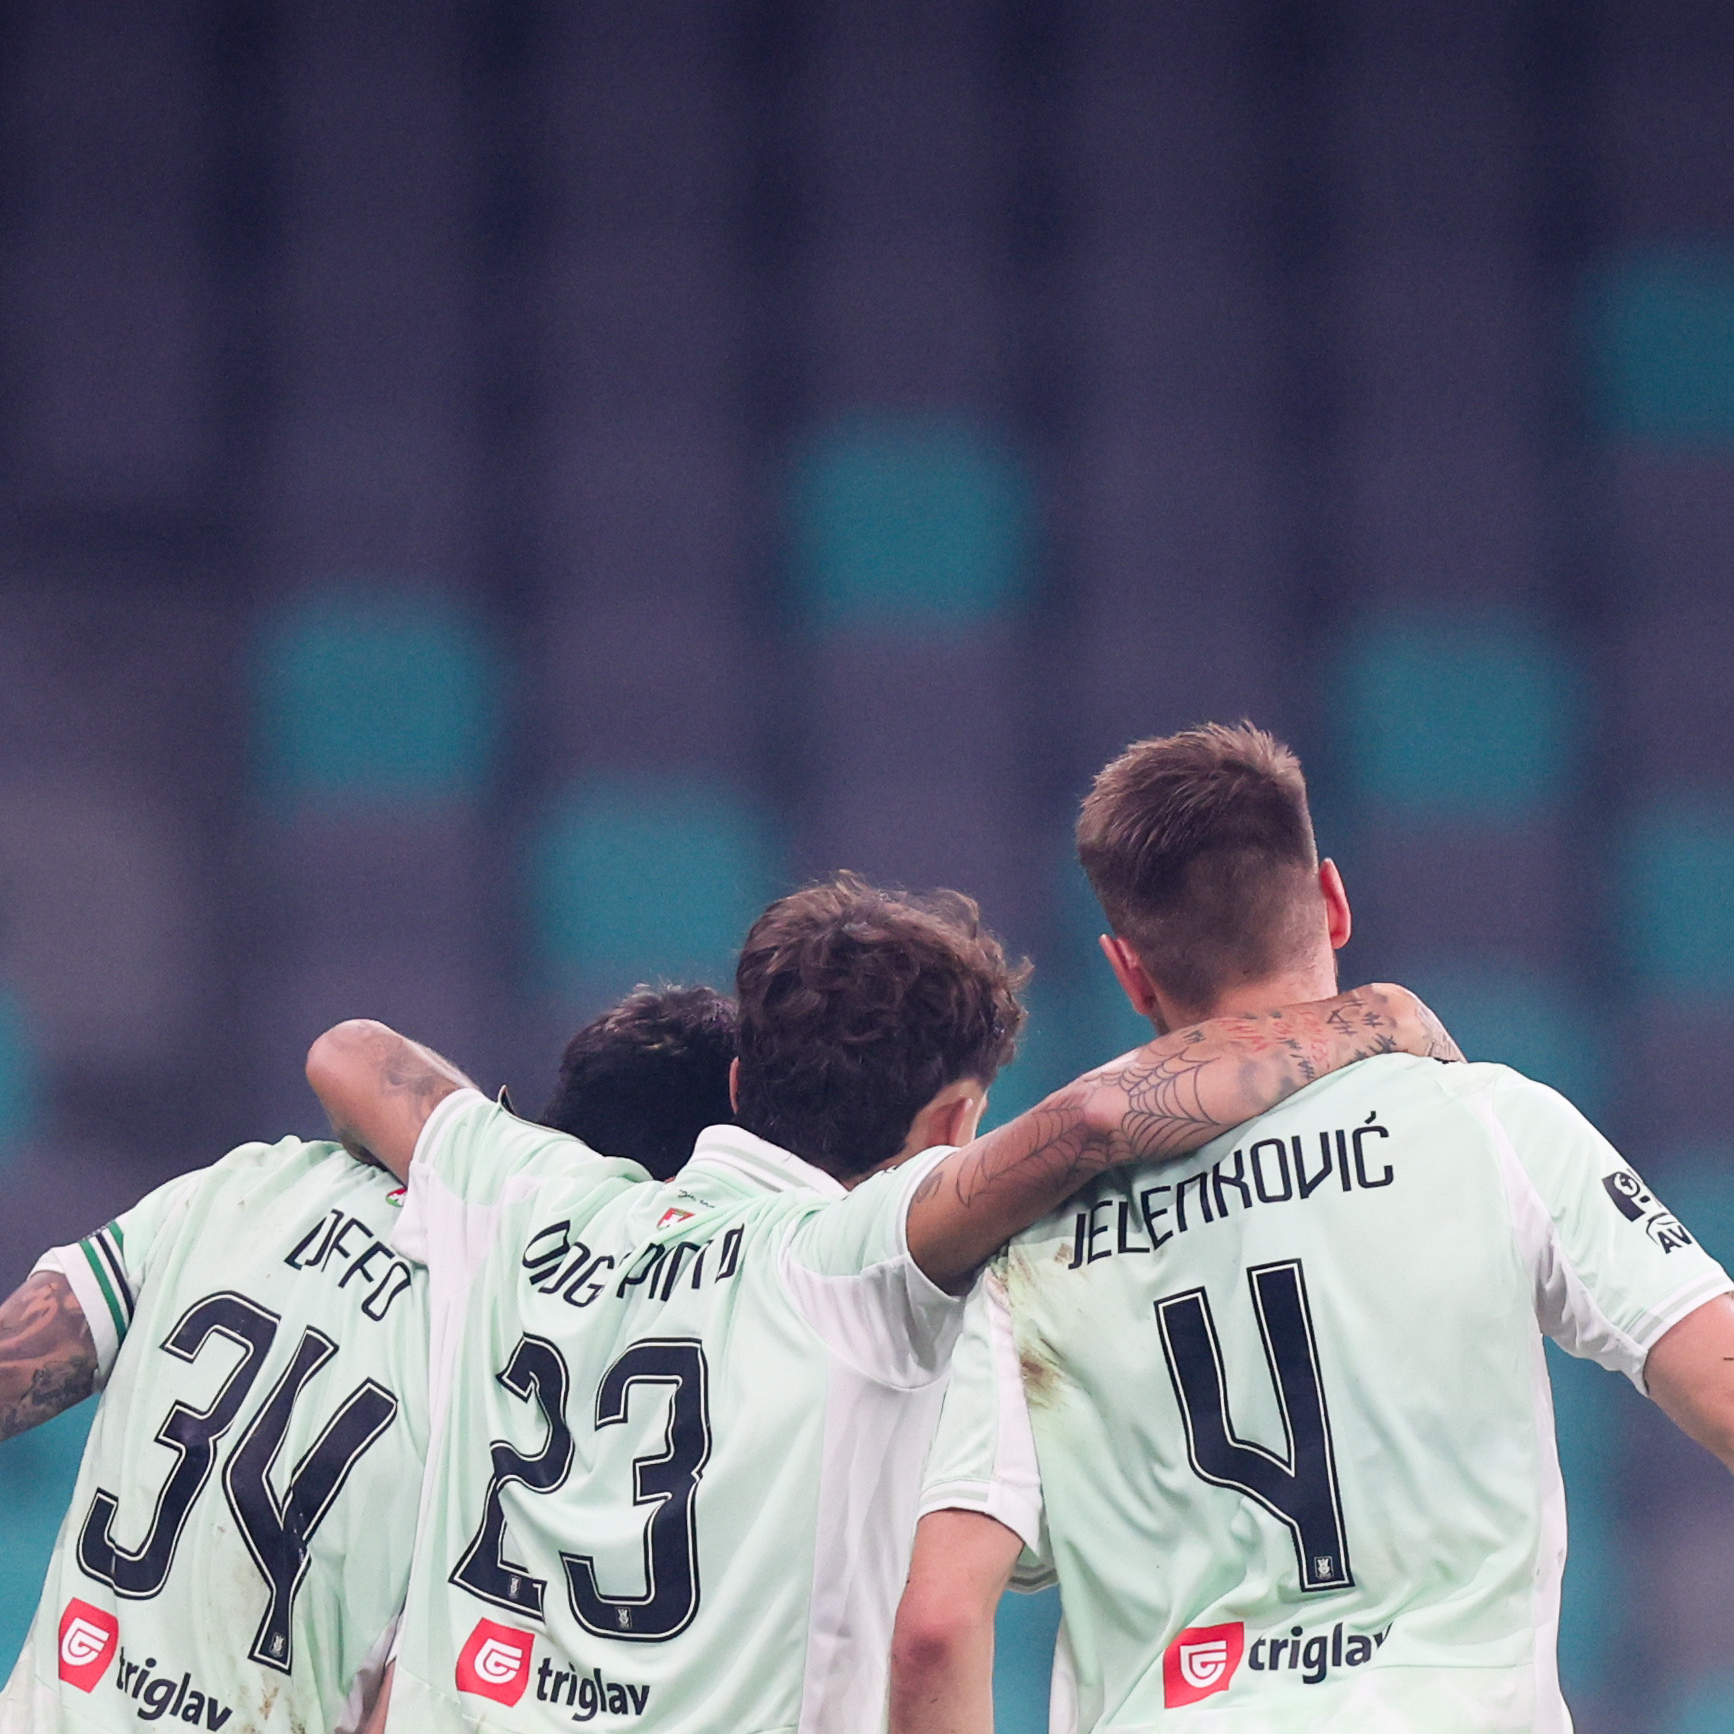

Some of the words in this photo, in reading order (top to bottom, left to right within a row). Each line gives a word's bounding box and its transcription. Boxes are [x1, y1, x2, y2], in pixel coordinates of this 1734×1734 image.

[1067, 1110, 1394, 1270] JELENKOVIĆ
[76, 1290, 399, 1676] 34
[448, 1331, 712, 1643] 23
[1153, 1257, 1356, 1593] 4
[116, 1646, 233, 1733] triglav
[536, 1657, 651, 1722] triglav
